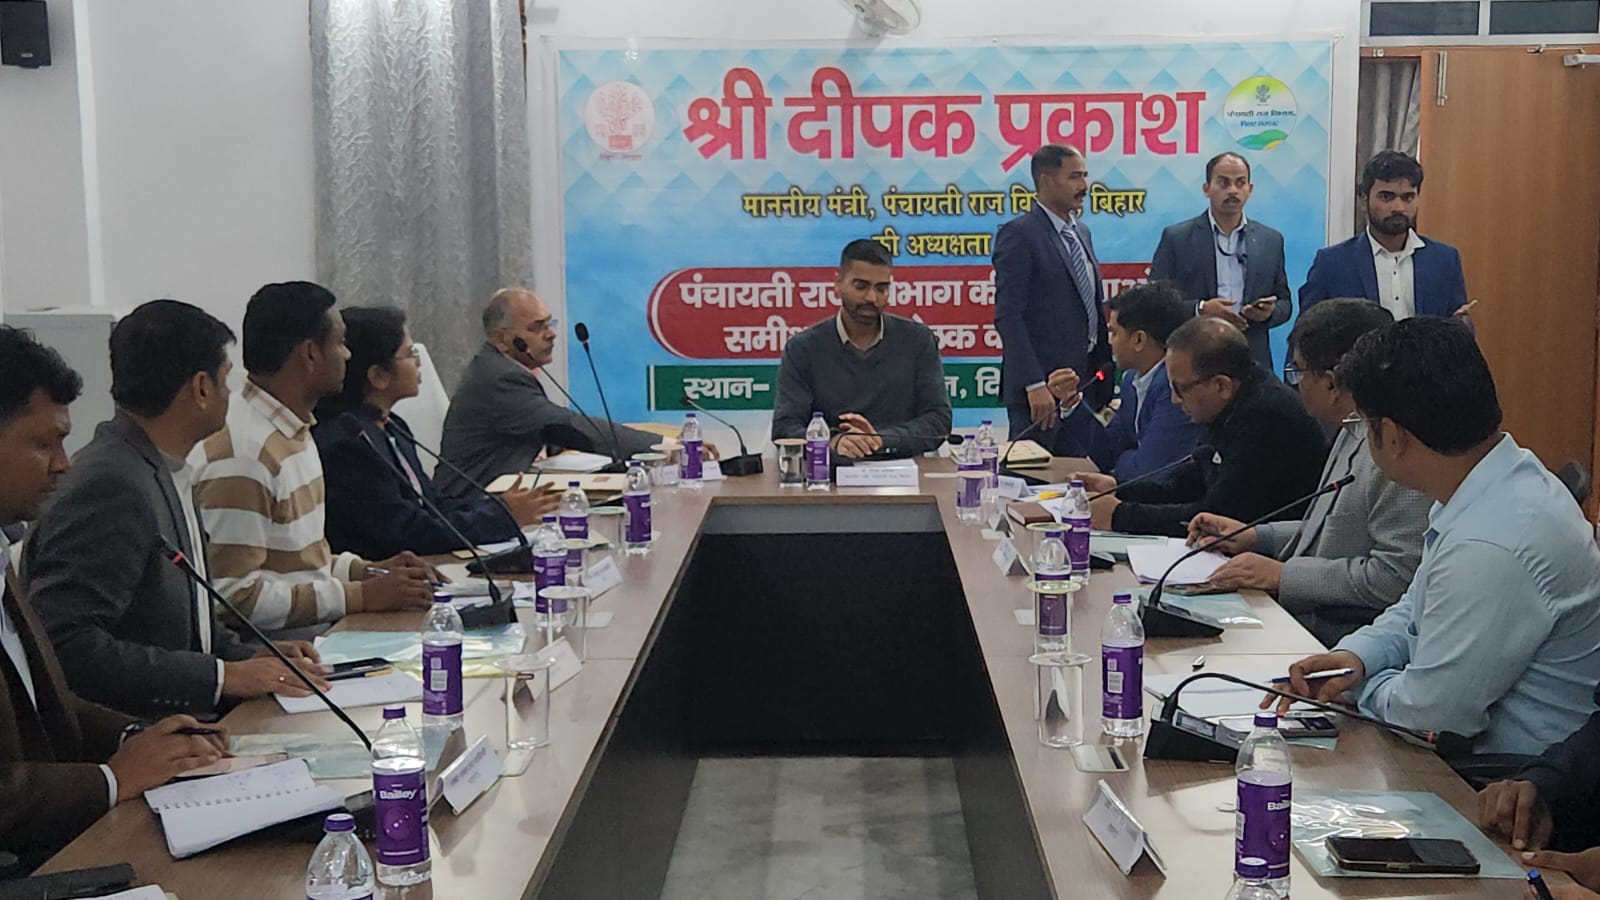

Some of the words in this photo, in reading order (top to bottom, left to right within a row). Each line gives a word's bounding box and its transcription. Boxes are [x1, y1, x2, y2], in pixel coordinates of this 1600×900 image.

[683, 67, 773, 160] श्री
[783, 67, 982, 159] दीपक
[994, 90, 1207, 173] प्रकाश
[742, 187, 822, 216] माननीय
[826, 186, 876, 219] मंत्री,
[883, 185, 963, 214] पंचायती
[968, 193, 1004, 214] राज
[1090, 184, 1146, 216] बिहार
[907, 234, 992, 256] अध्यक्षता
[678, 271, 795, 308] पंचायती
[683, 376, 770, 400] स्थान-
